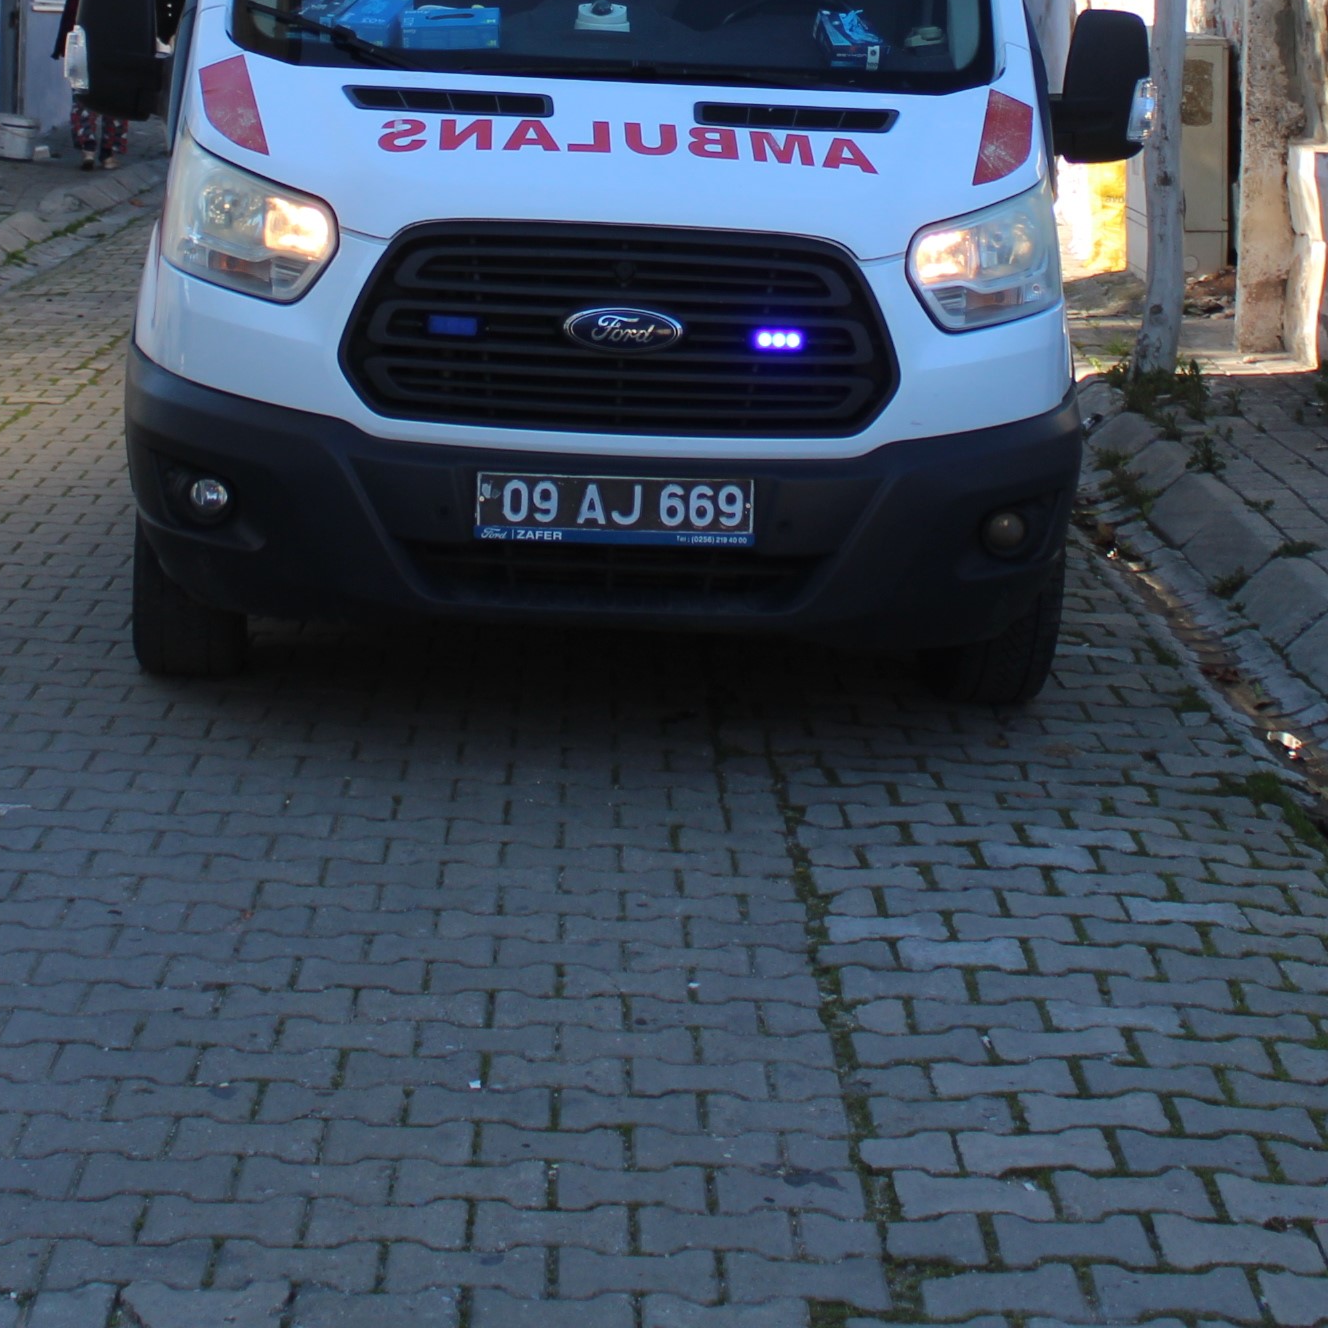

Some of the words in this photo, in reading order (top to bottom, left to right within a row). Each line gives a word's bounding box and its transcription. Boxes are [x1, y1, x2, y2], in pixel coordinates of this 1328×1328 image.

[591, 315, 655, 343] Ford
[502, 479, 559, 523] 09
[577, 483, 643, 526] AJ
[659, 483, 745, 527] 669
[480, 528, 508, 540] Ford
[516, 529, 563, 541] ZAFER
[691, 535, 715, 544] (0256)
